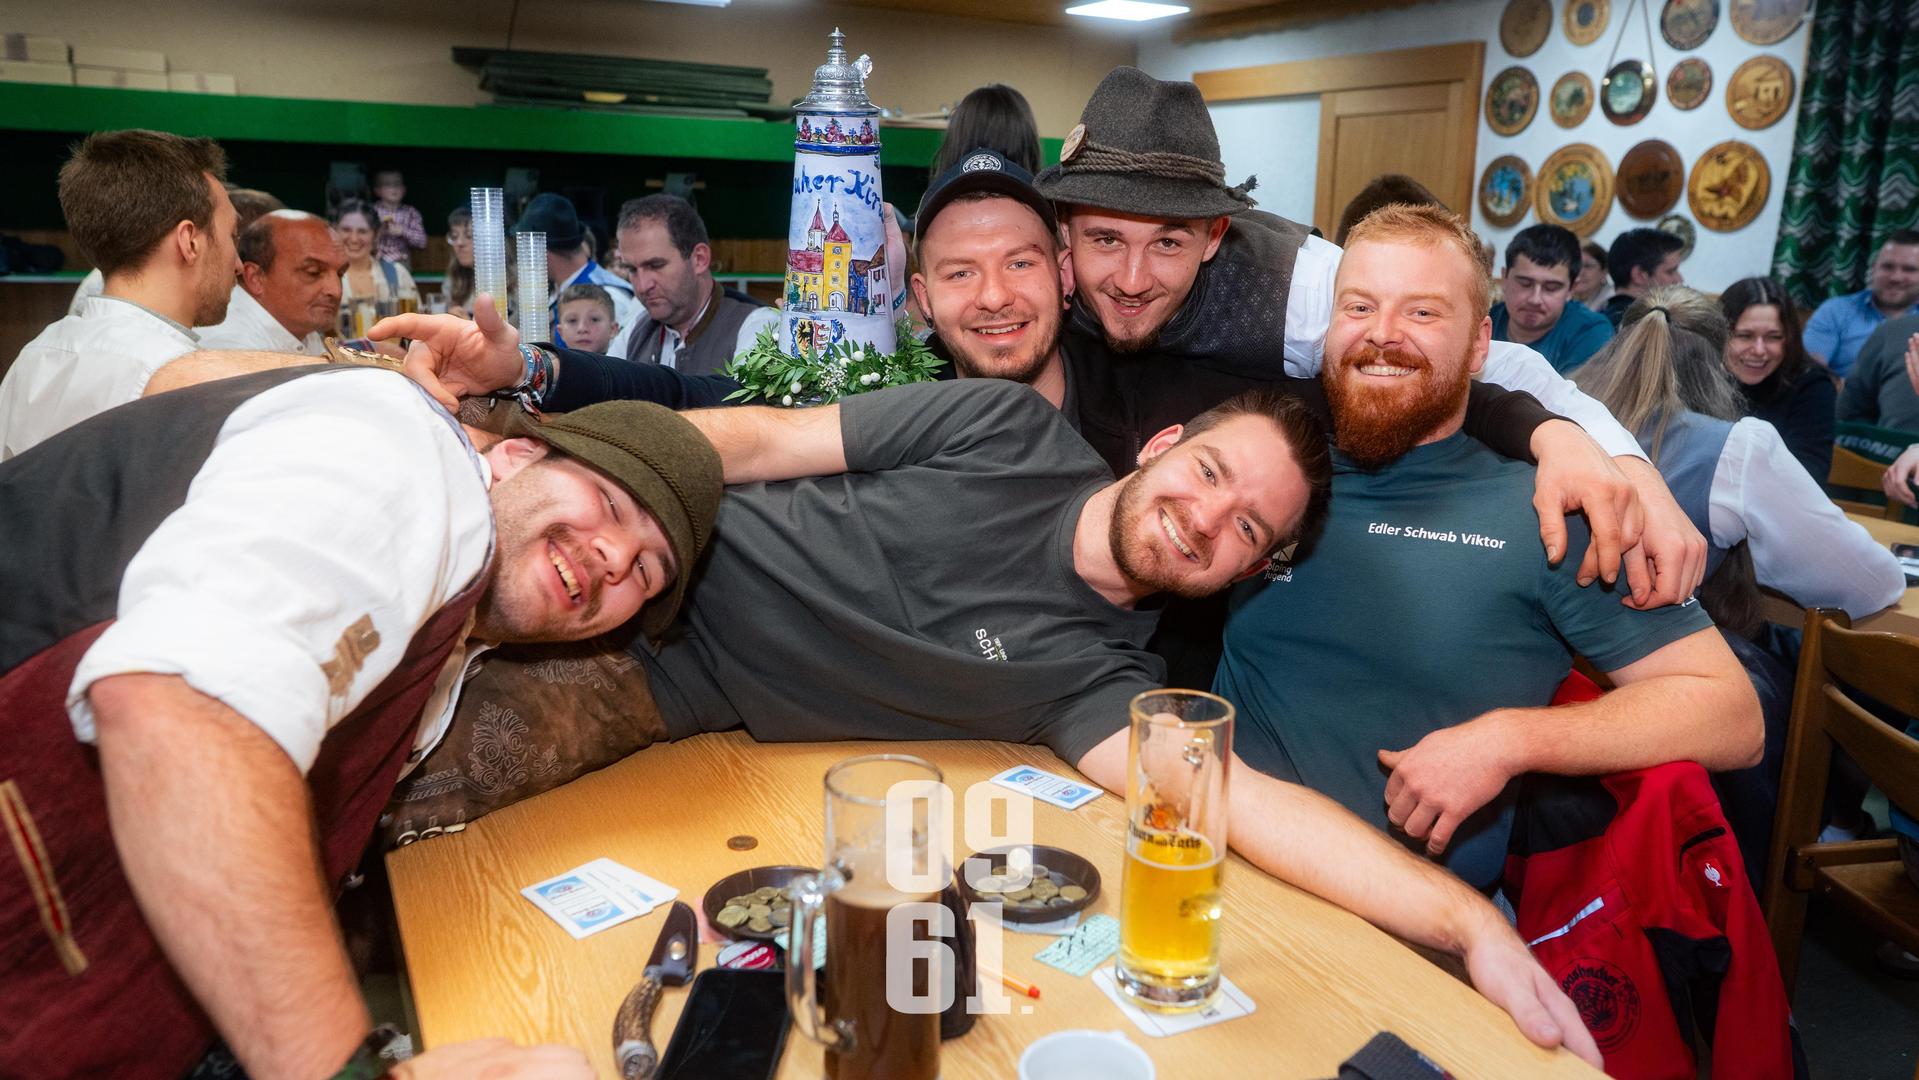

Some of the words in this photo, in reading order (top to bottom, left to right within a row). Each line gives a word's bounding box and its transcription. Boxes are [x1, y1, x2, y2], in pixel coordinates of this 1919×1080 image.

[793, 164, 845, 194] uher
[1367, 522, 1402, 536] Edler
[1403, 526, 1458, 543] Schwab
[1461, 533, 1506, 549] Viktor
[1265, 562, 1292, 576] olping
